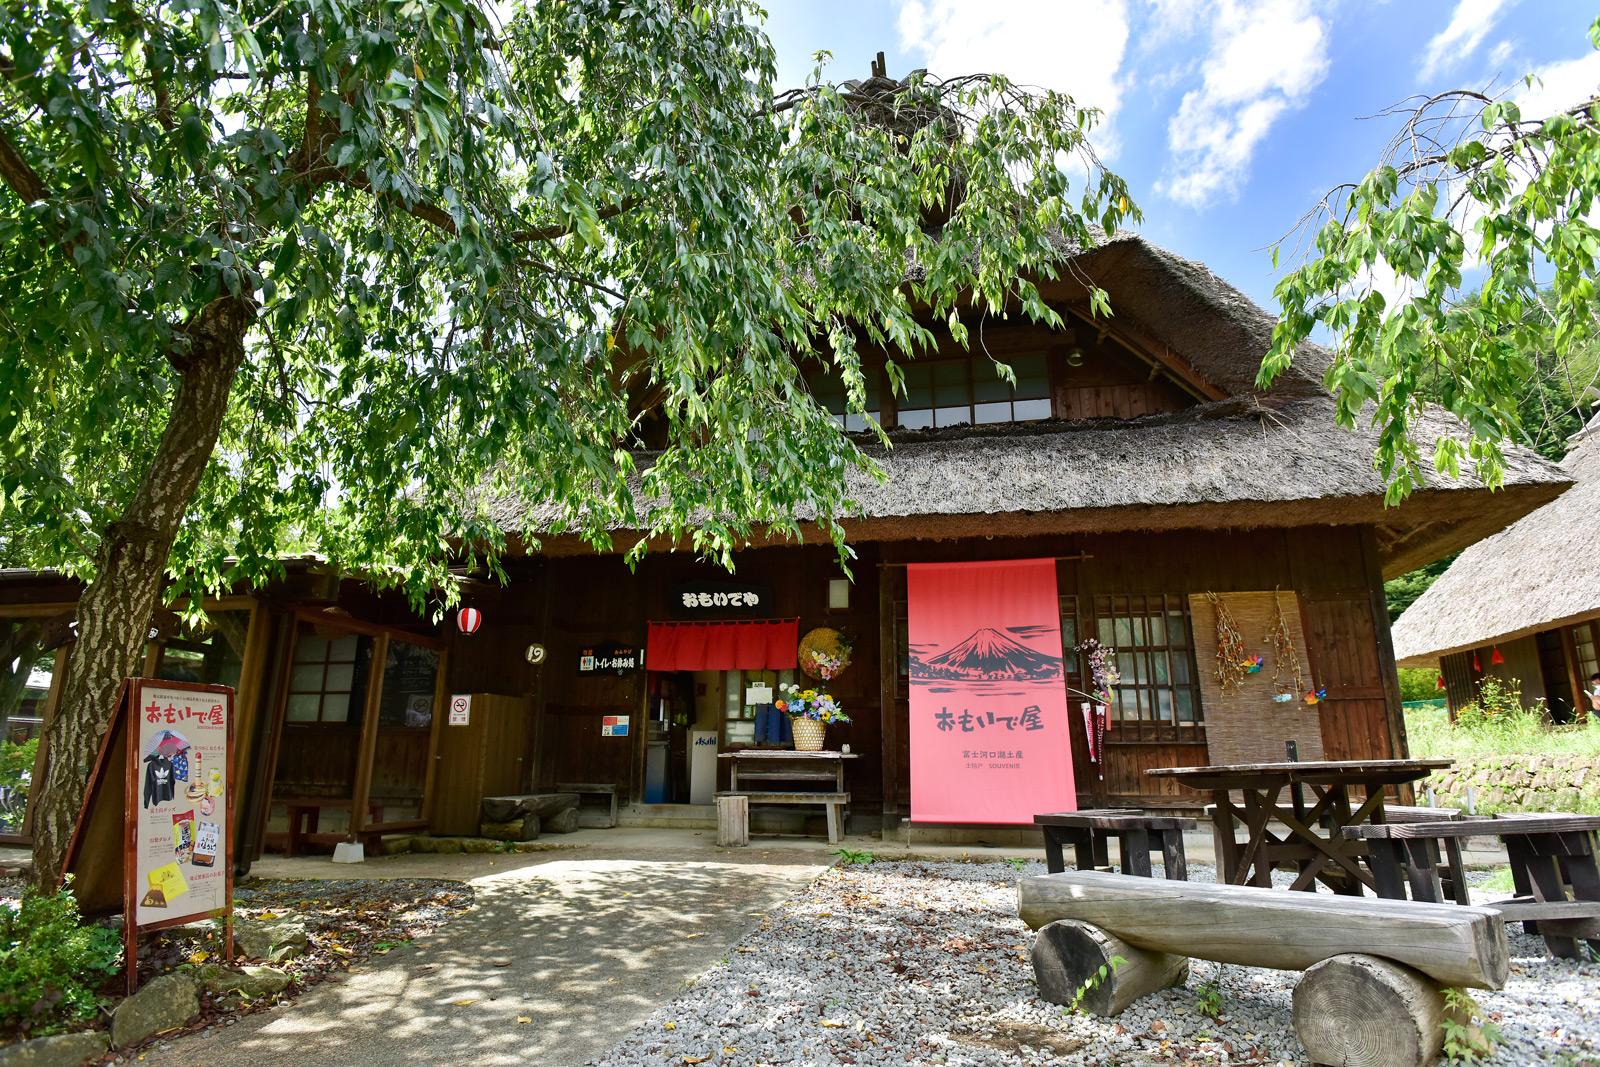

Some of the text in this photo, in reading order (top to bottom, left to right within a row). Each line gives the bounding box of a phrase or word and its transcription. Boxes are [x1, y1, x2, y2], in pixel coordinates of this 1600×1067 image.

[682, 592, 759, 608] おもいでや
[527, 645, 544, 662] 19
[145, 701, 224, 725] おもいで屋
[934, 705, 1044, 732] おもいで屋
[695, 736, 717, 746] Asahi
[963, 751, 1024, 759] 富士河口湖土産
